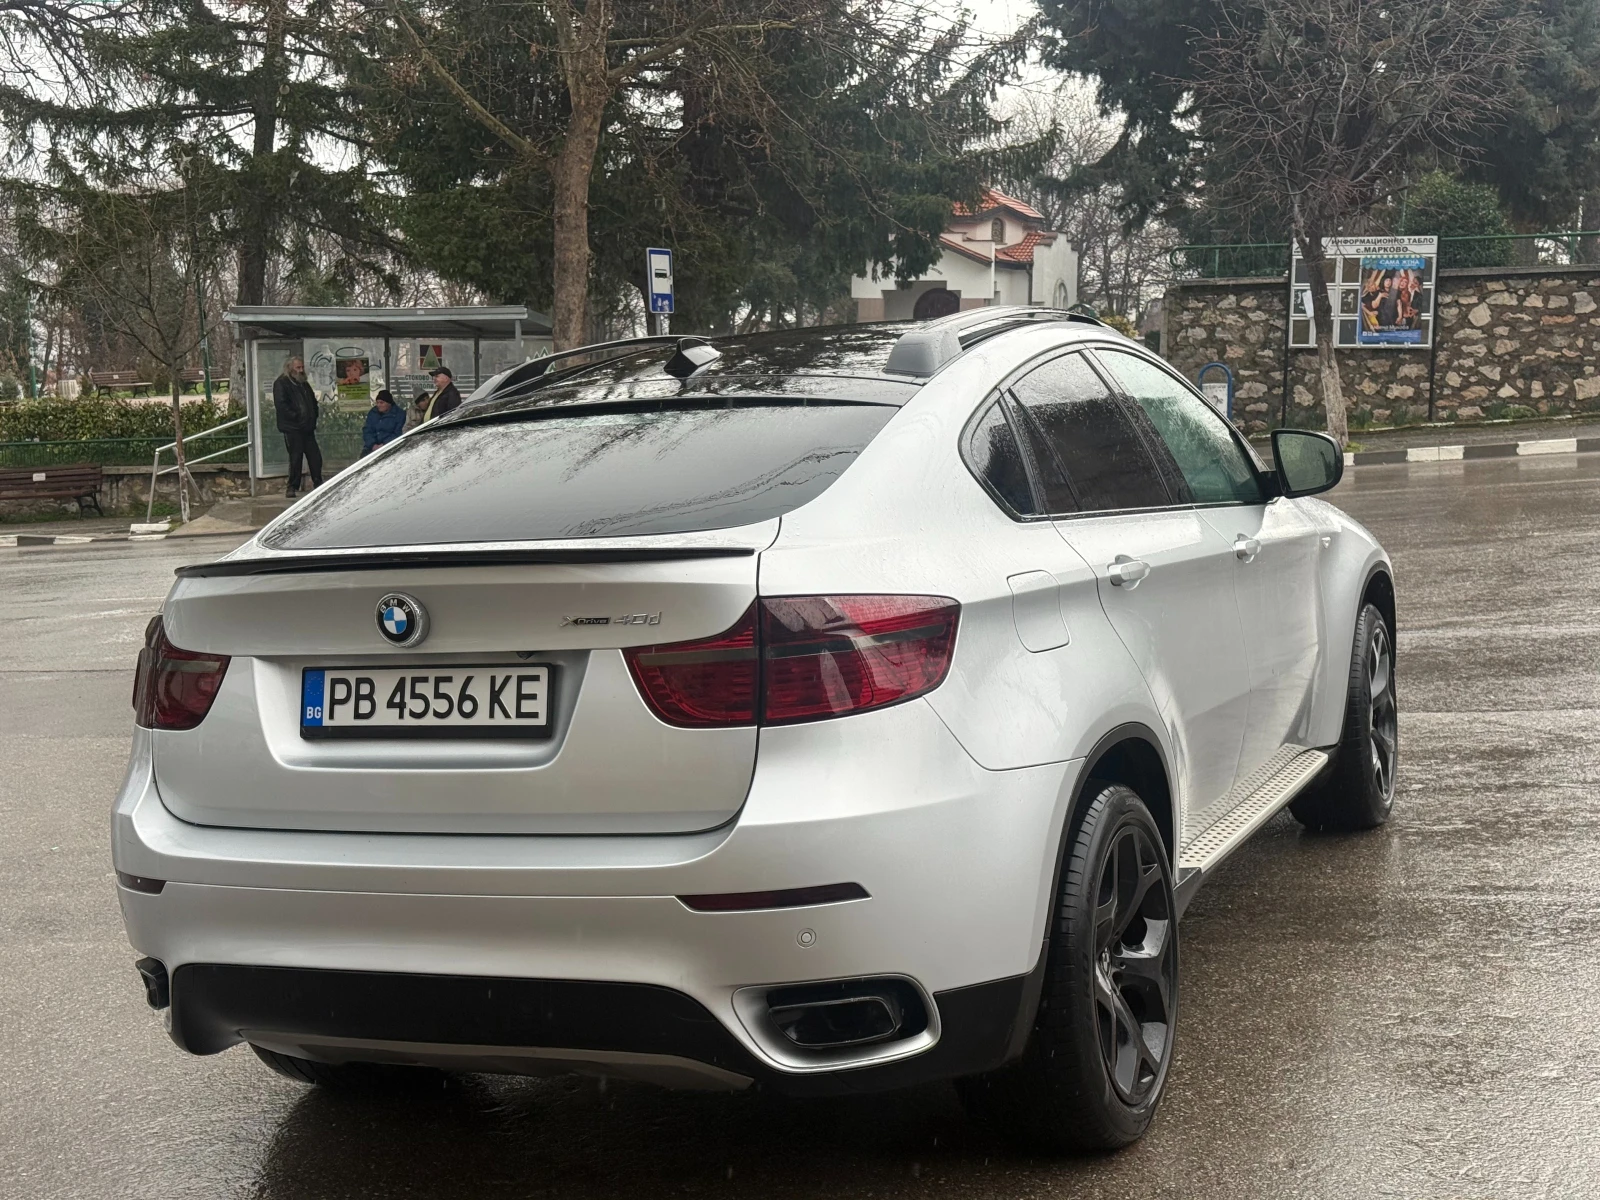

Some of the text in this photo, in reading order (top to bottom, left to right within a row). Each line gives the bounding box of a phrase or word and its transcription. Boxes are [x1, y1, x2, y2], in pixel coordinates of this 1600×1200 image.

[1331, 237, 1405, 245] ИНФОРМАЦИОННО
[380, 598, 411, 613] BMW
[613, 611, 662, 626] 40d
[328, 675, 541, 720] PB 4556 KE
[306, 706, 322, 719] BG
